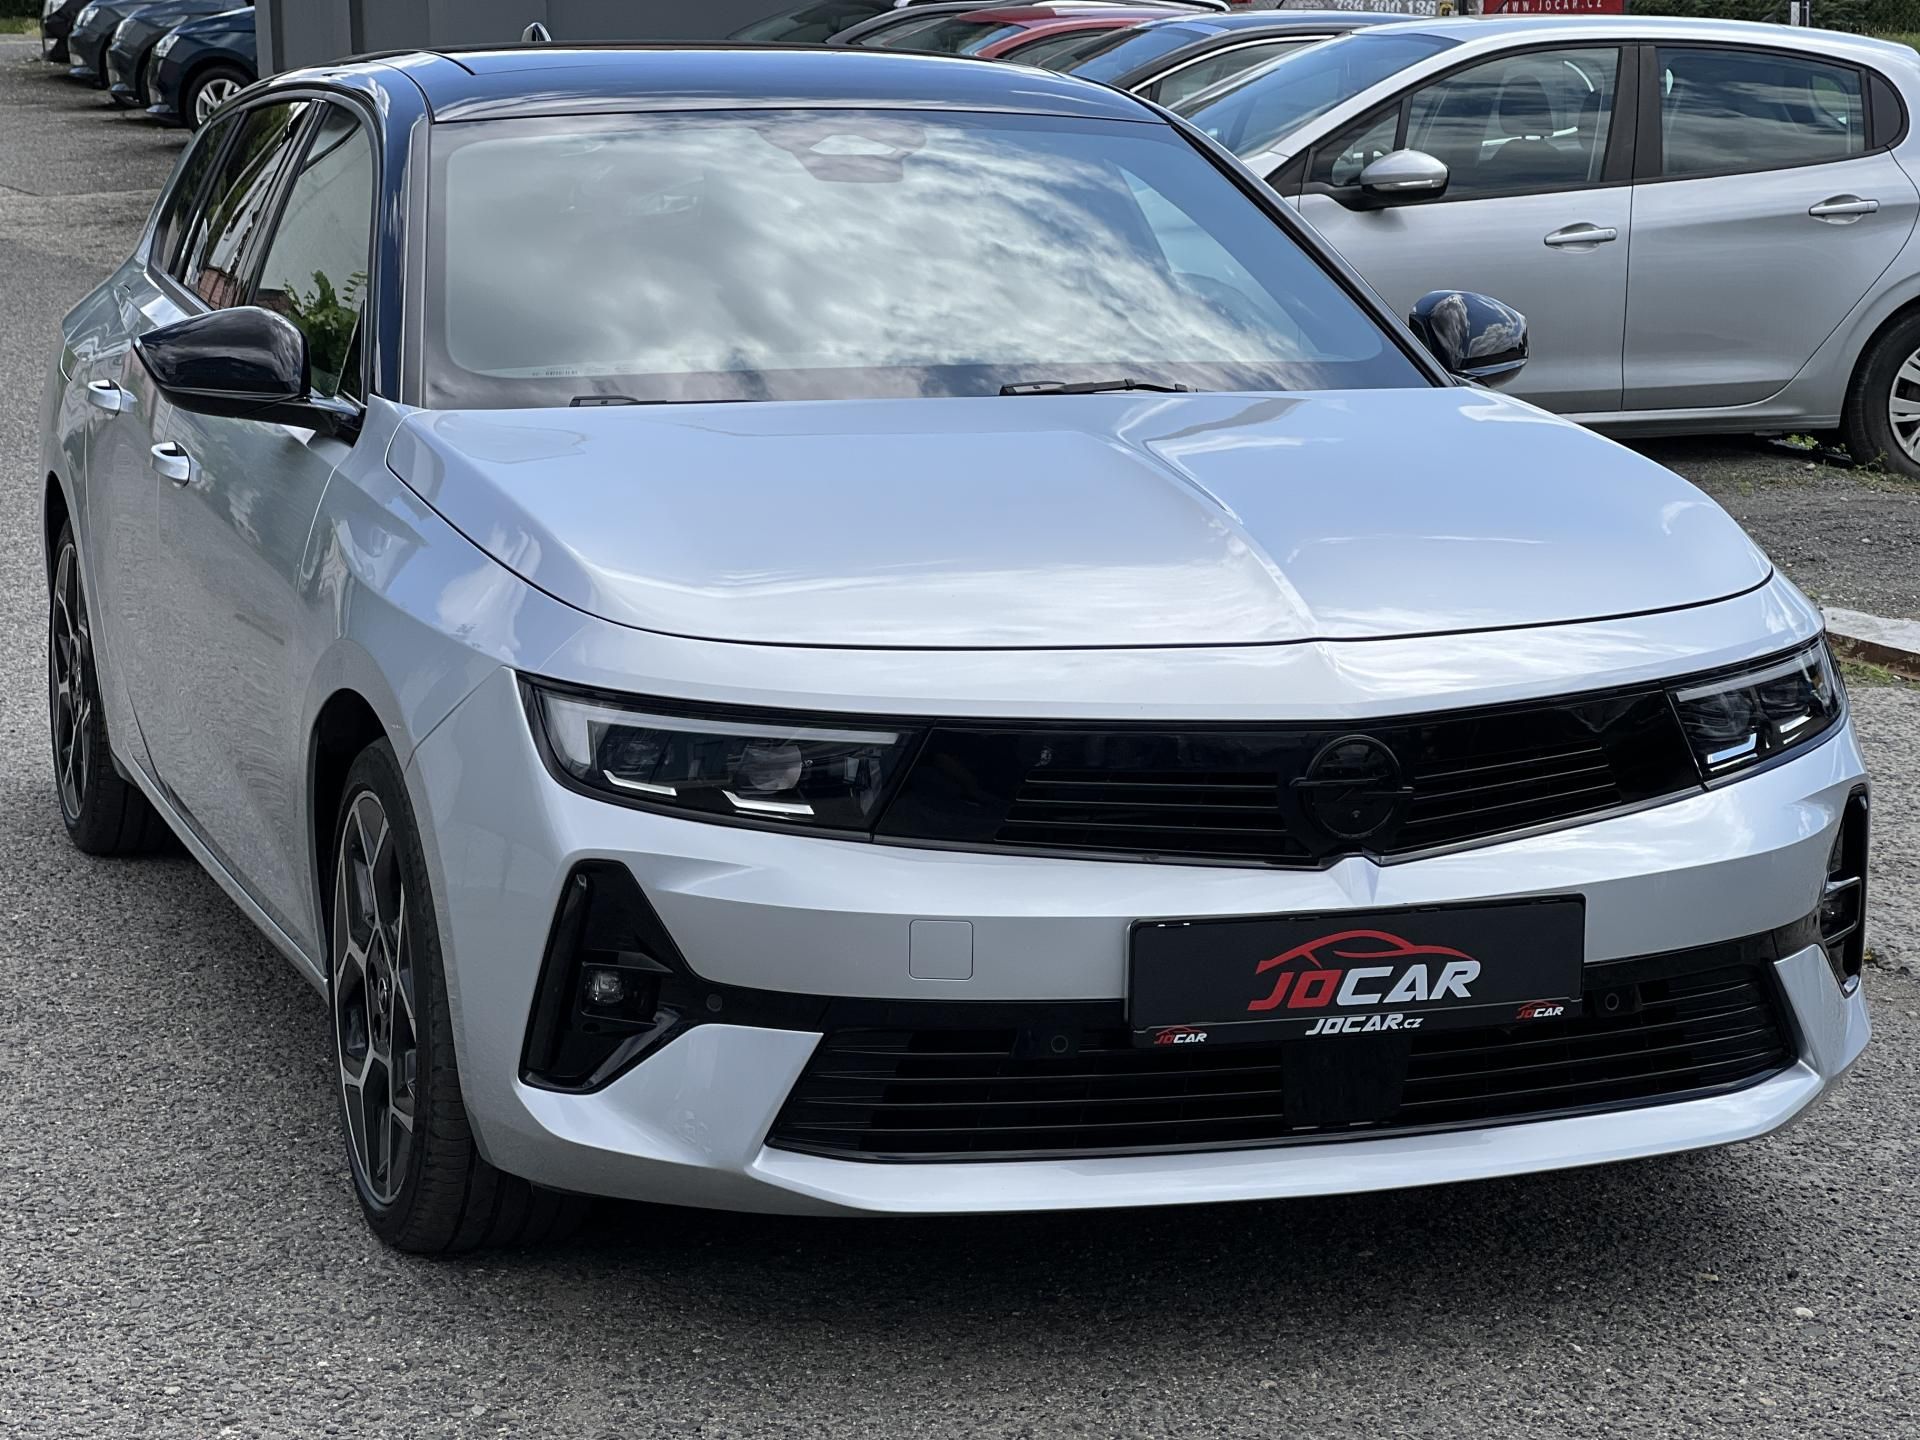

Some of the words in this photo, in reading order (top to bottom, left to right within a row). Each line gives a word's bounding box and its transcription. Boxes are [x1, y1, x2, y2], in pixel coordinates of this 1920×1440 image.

[1407, 1, 1436, 15] 136
[1247, 960, 1481, 1011] JOCAR
[1516, 1006, 1564, 1020] JOCAR
[1154, 1032, 1208, 1045] JOCAR
